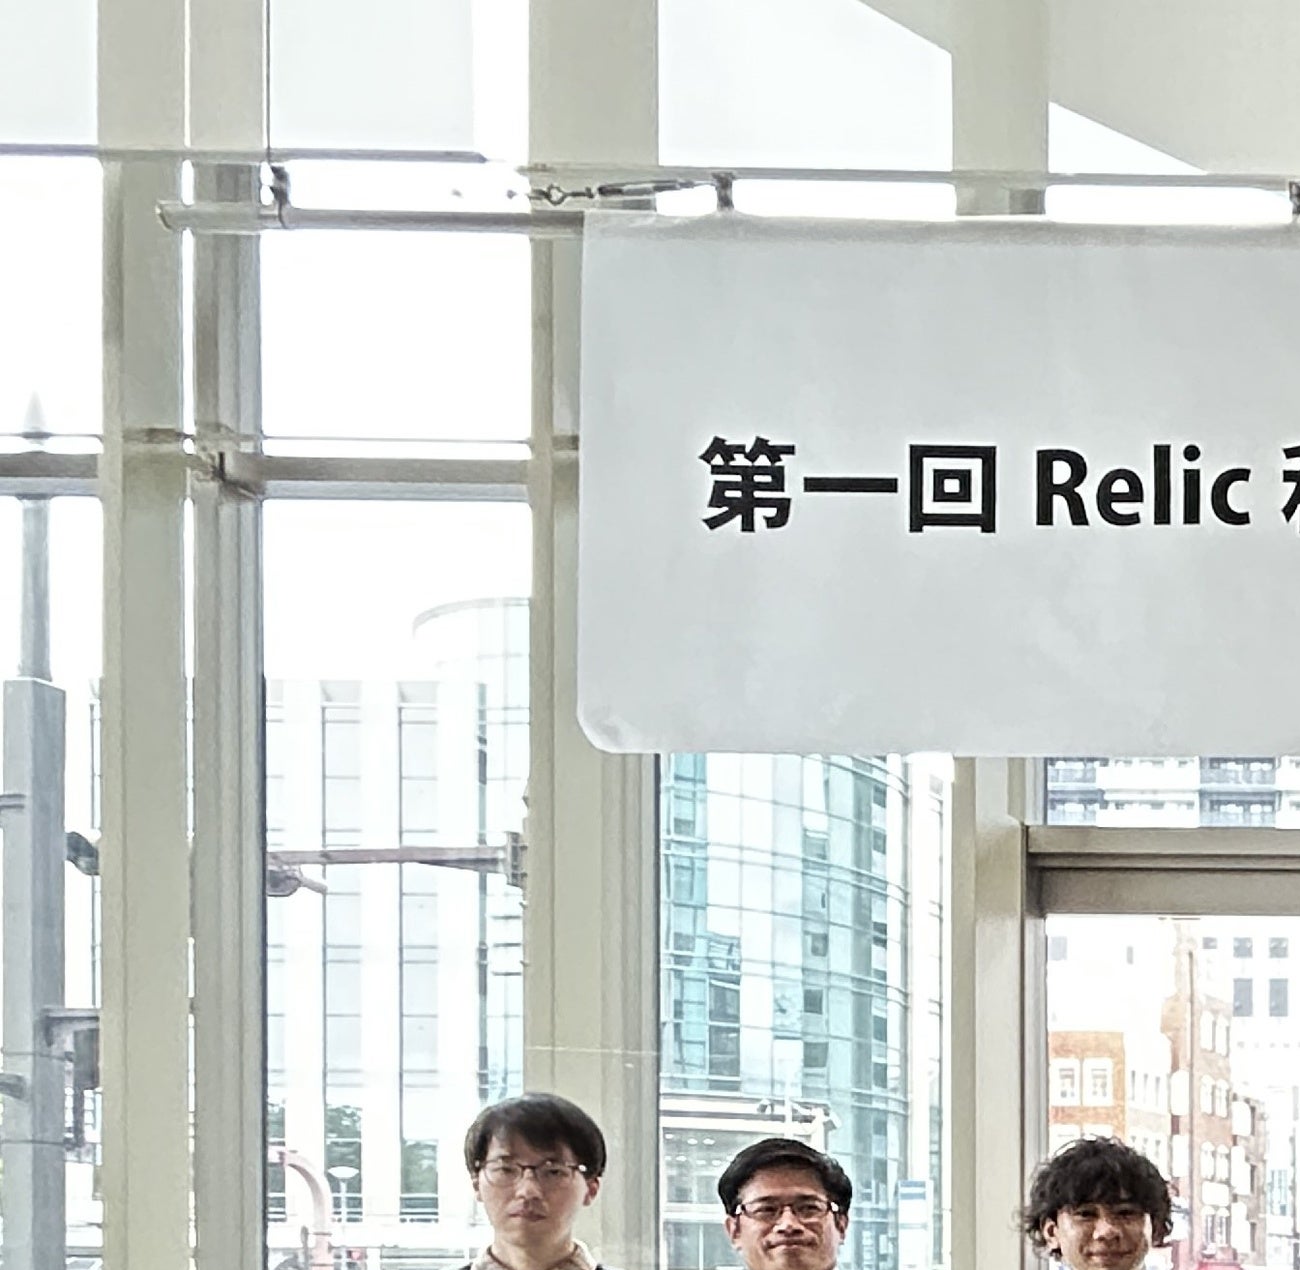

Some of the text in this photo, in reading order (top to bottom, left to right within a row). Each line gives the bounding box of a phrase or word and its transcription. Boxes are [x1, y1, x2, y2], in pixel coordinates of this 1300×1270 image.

[698, 436, 997, 534] 第一回
[1035, 444, 1252, 527] Relic
